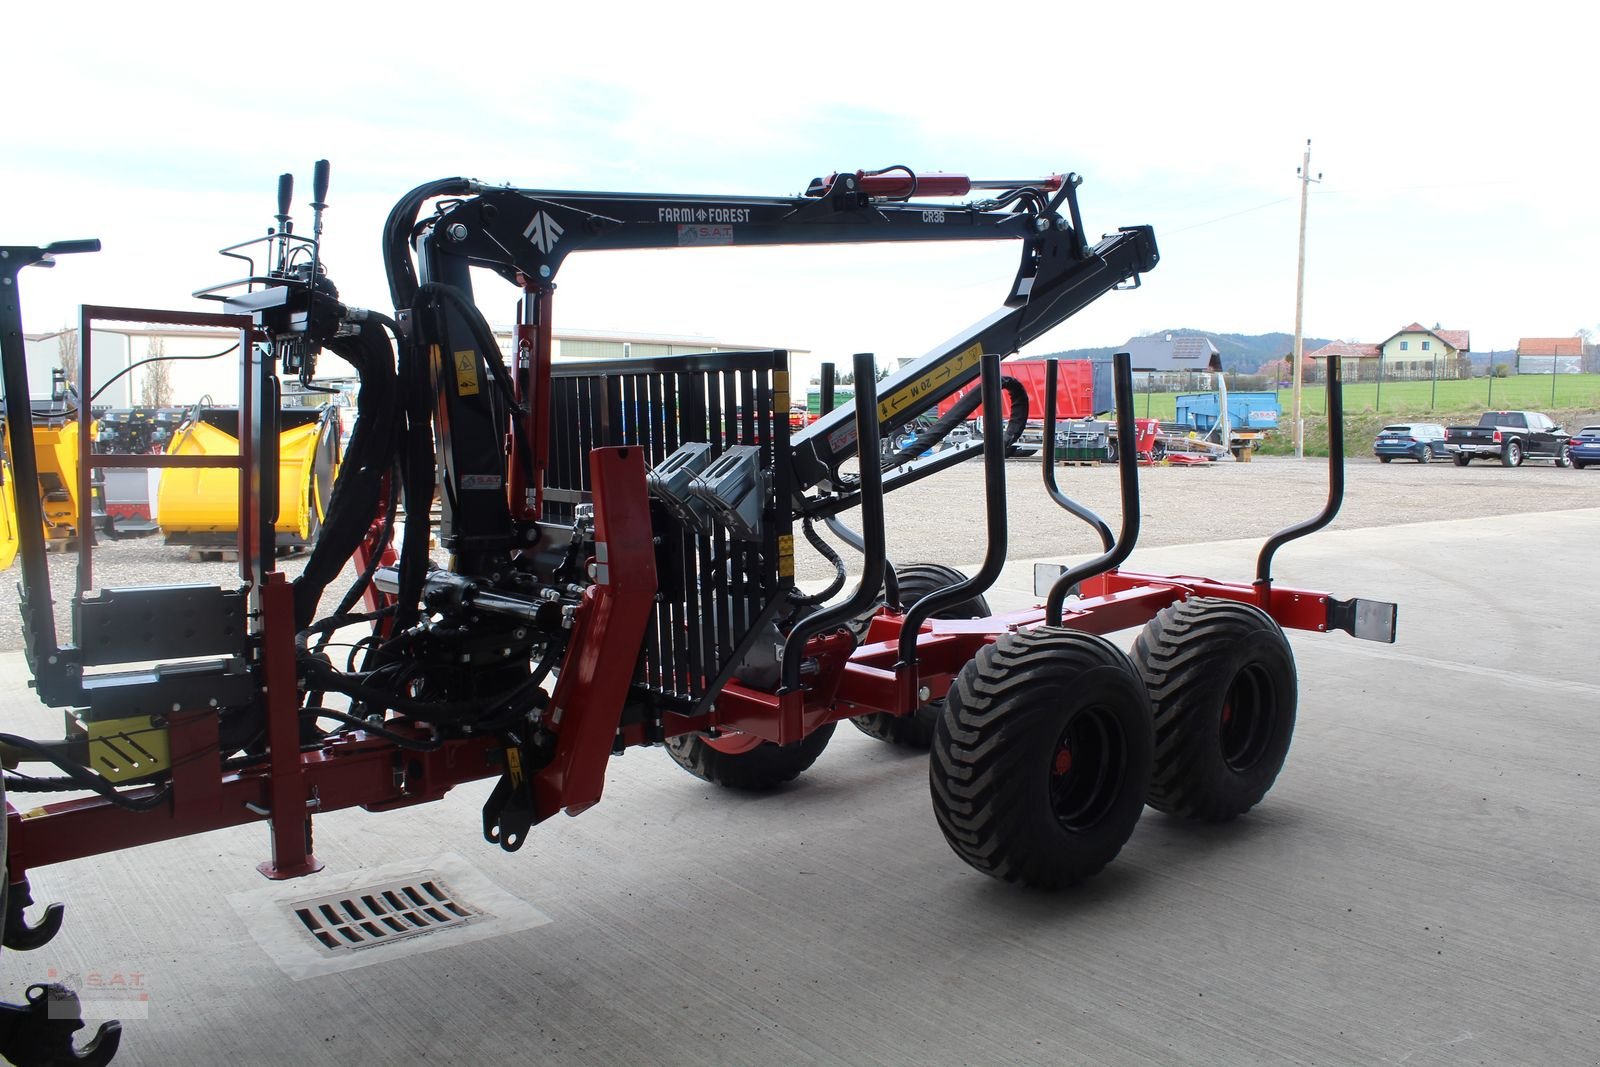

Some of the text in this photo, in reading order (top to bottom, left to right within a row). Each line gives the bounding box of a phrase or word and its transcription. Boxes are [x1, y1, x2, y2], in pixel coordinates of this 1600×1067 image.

[658, 207, 750, 223] FARMI FOREST
[922, 211, 945, 223] CR36
